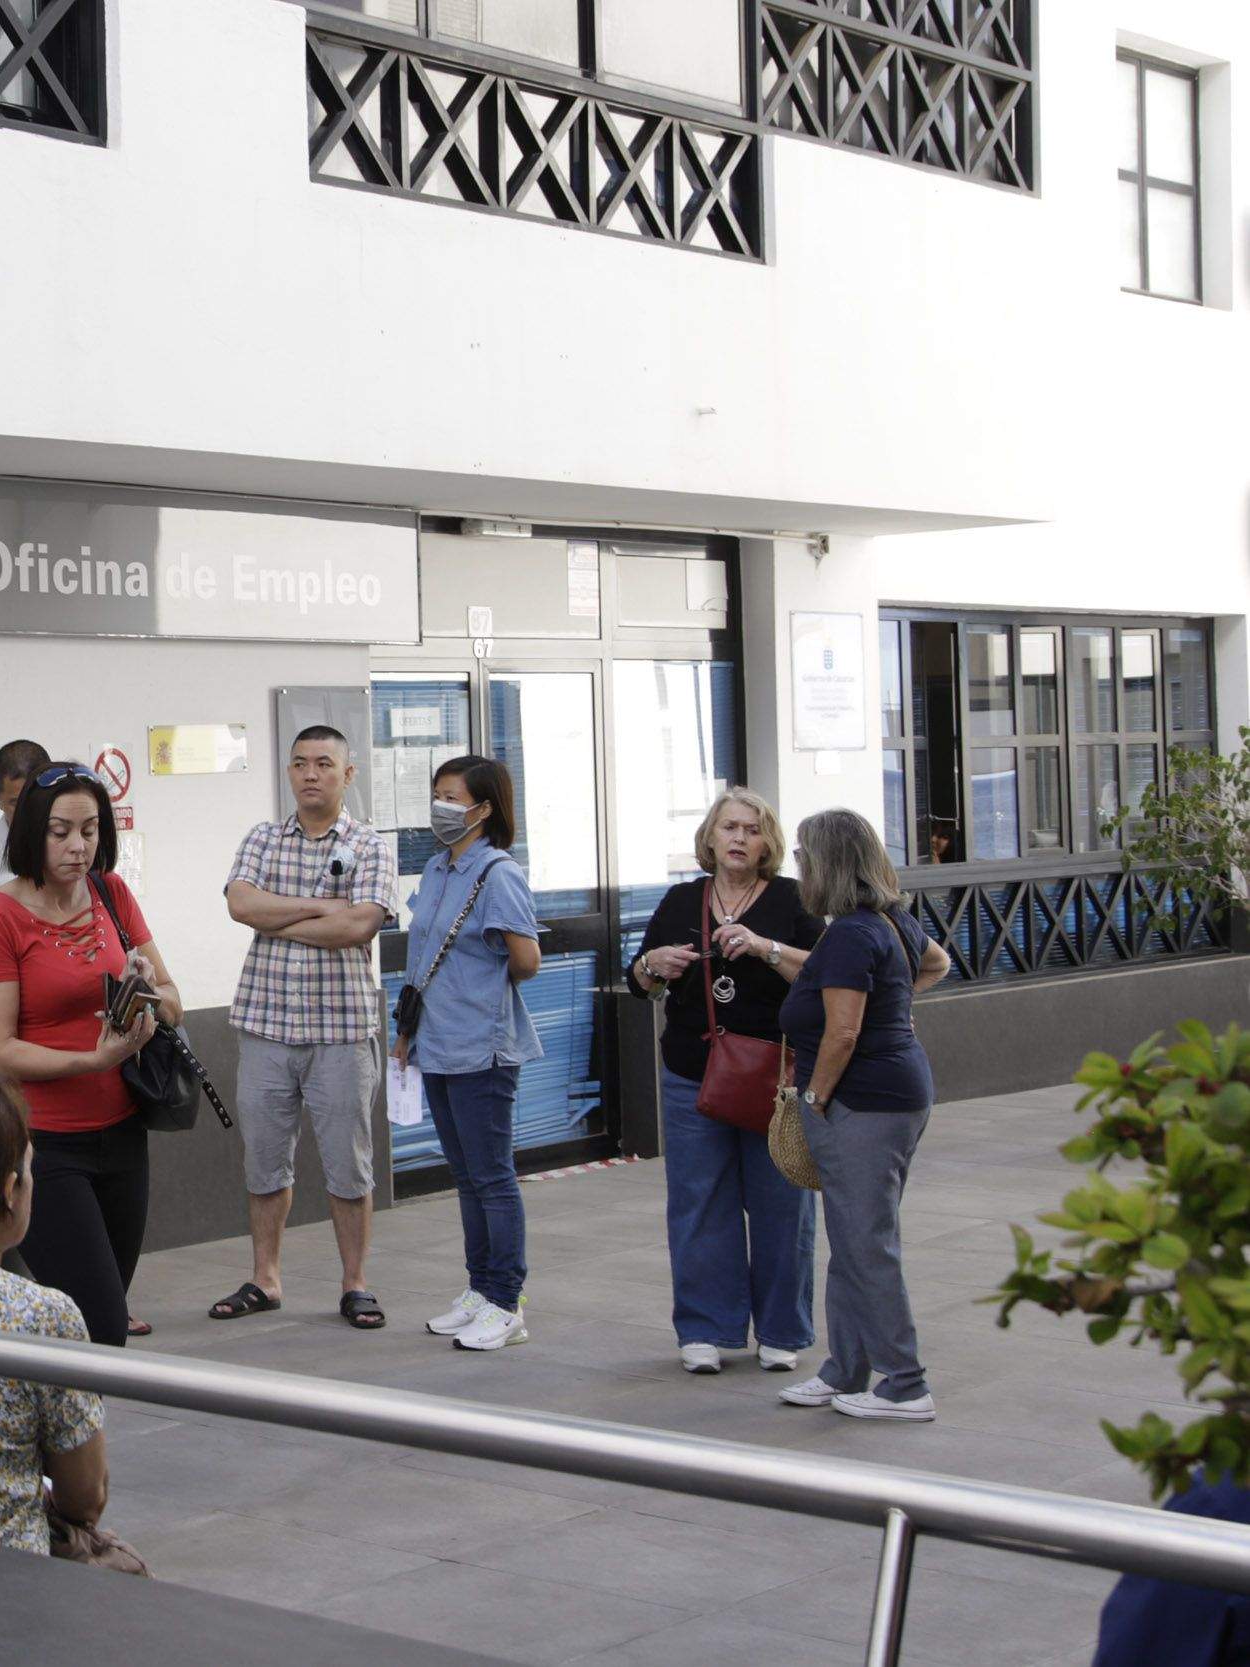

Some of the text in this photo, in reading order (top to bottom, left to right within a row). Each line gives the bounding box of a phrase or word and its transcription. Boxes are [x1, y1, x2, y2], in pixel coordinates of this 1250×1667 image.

[164, 551, 218, 601] de
[232, 554, 383, 616] Empleo
[473, 638, 495, 658] 67
